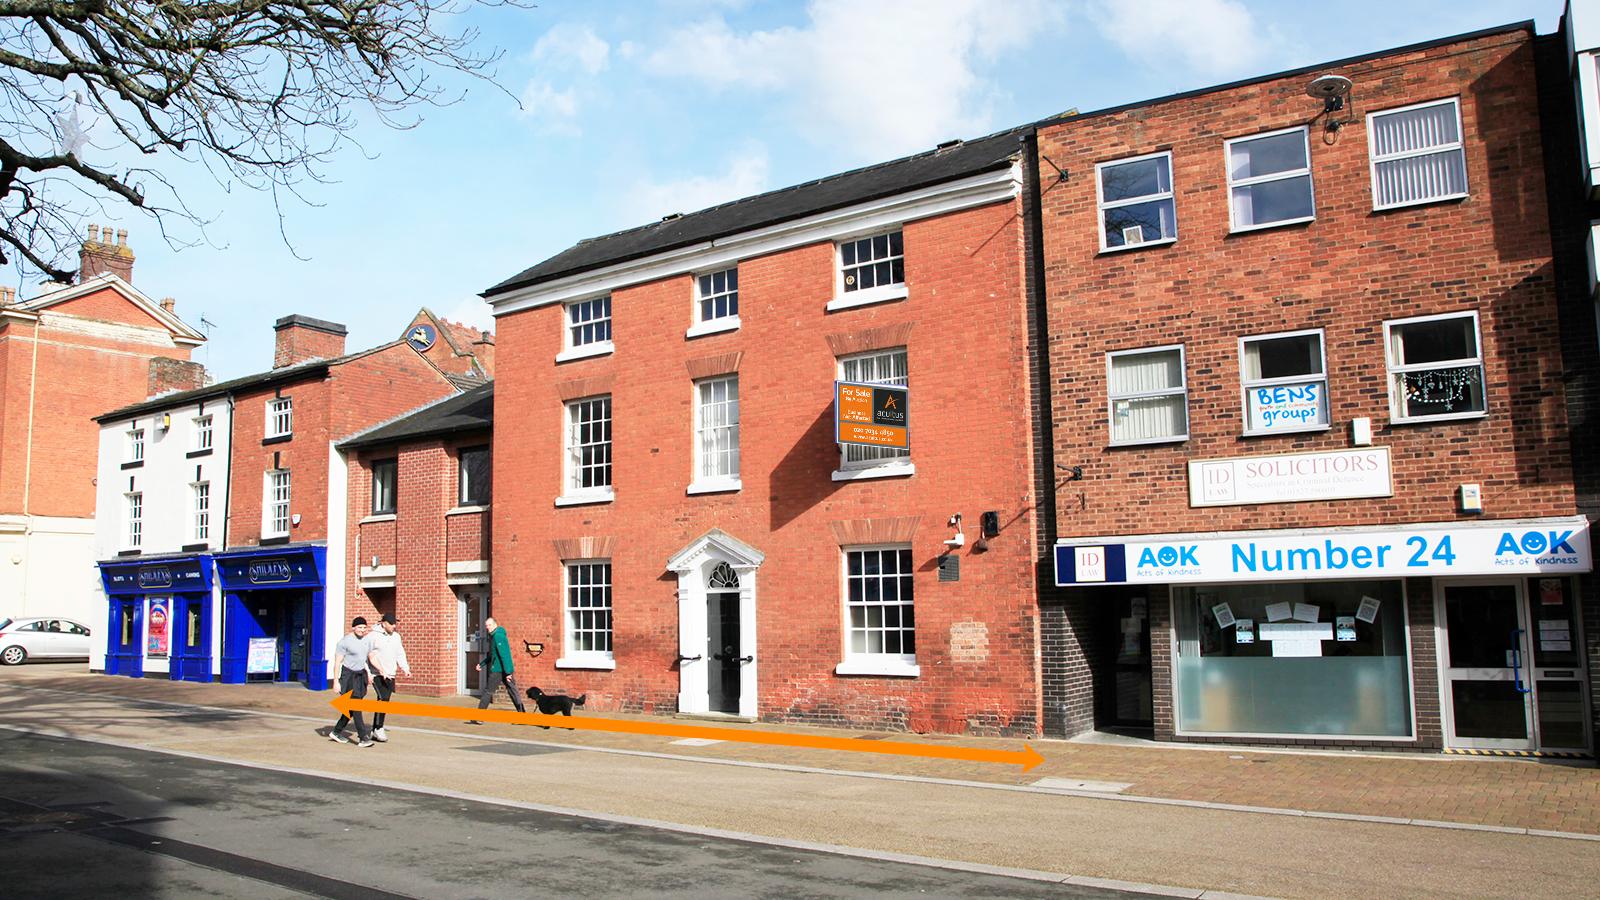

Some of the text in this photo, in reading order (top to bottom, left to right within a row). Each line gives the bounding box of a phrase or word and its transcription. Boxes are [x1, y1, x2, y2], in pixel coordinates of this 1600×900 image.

[842, 387, 871, 398] For Sale
[1258, 384, 1316, 405] BENS
[1263, 407, 1316, 427] groups
[1245, 454, 1378, 479] SOLICITORS
[1208, 468, 1230, 484] ID
[1208, 487, 1229, 497] LAW
[1081, 553, 1099, 566] ID
[1231, 535, 1457, 572] Number 24
[1494, 557, 1515, 565] Acts
[1518, 556, 1530, 565] of
[1136, 569, 1153, 577] Acts
[1155, 567, 1165, 576] of
